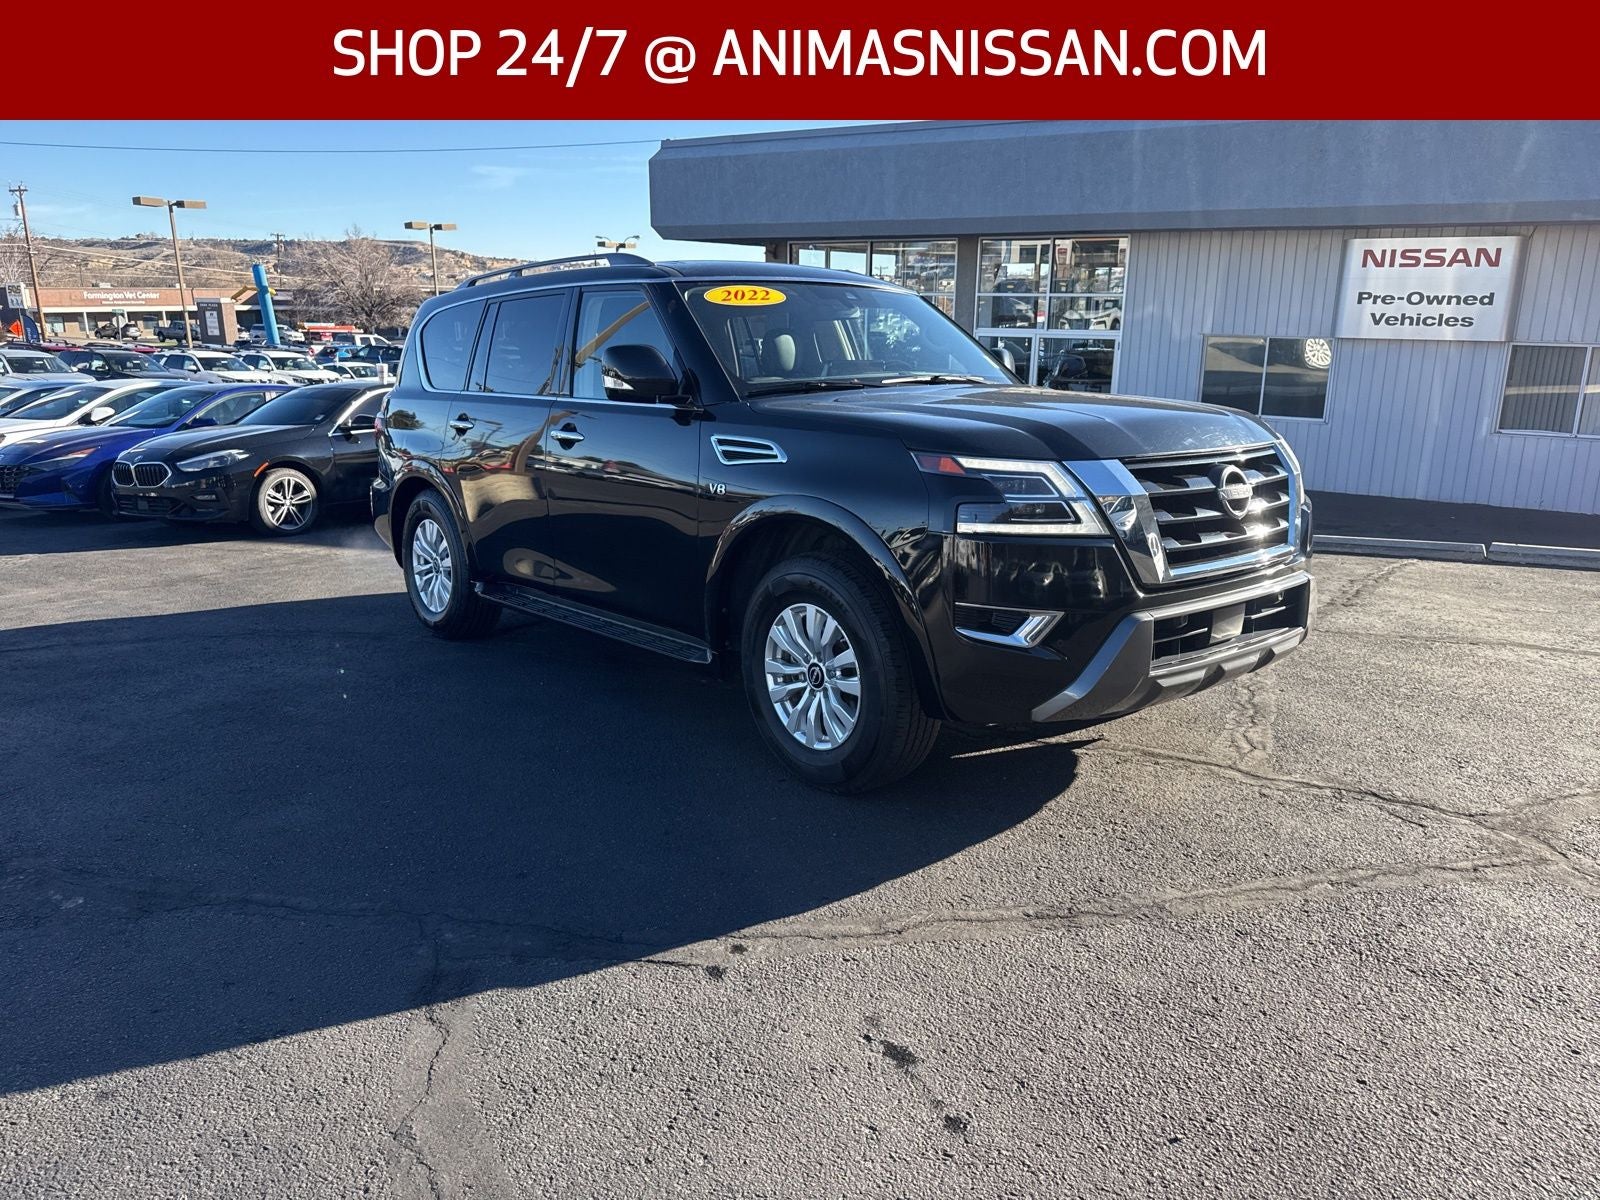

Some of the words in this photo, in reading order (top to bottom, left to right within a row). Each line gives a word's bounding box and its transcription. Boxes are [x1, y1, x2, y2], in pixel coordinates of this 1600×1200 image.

[1361, 247, 1502, 268] NISSAN
[83, 291, 124, 301] Farmington
[123, 291, 136, 299] Vet
[136, 291, 160, 300] Center
[720, 289, 770, 302] 2022
[1356, 291, 1495, 306] Pre-Owned
[1370, 312, 1474, 328] Vehicles
[709, 482, 726, 495] V8
